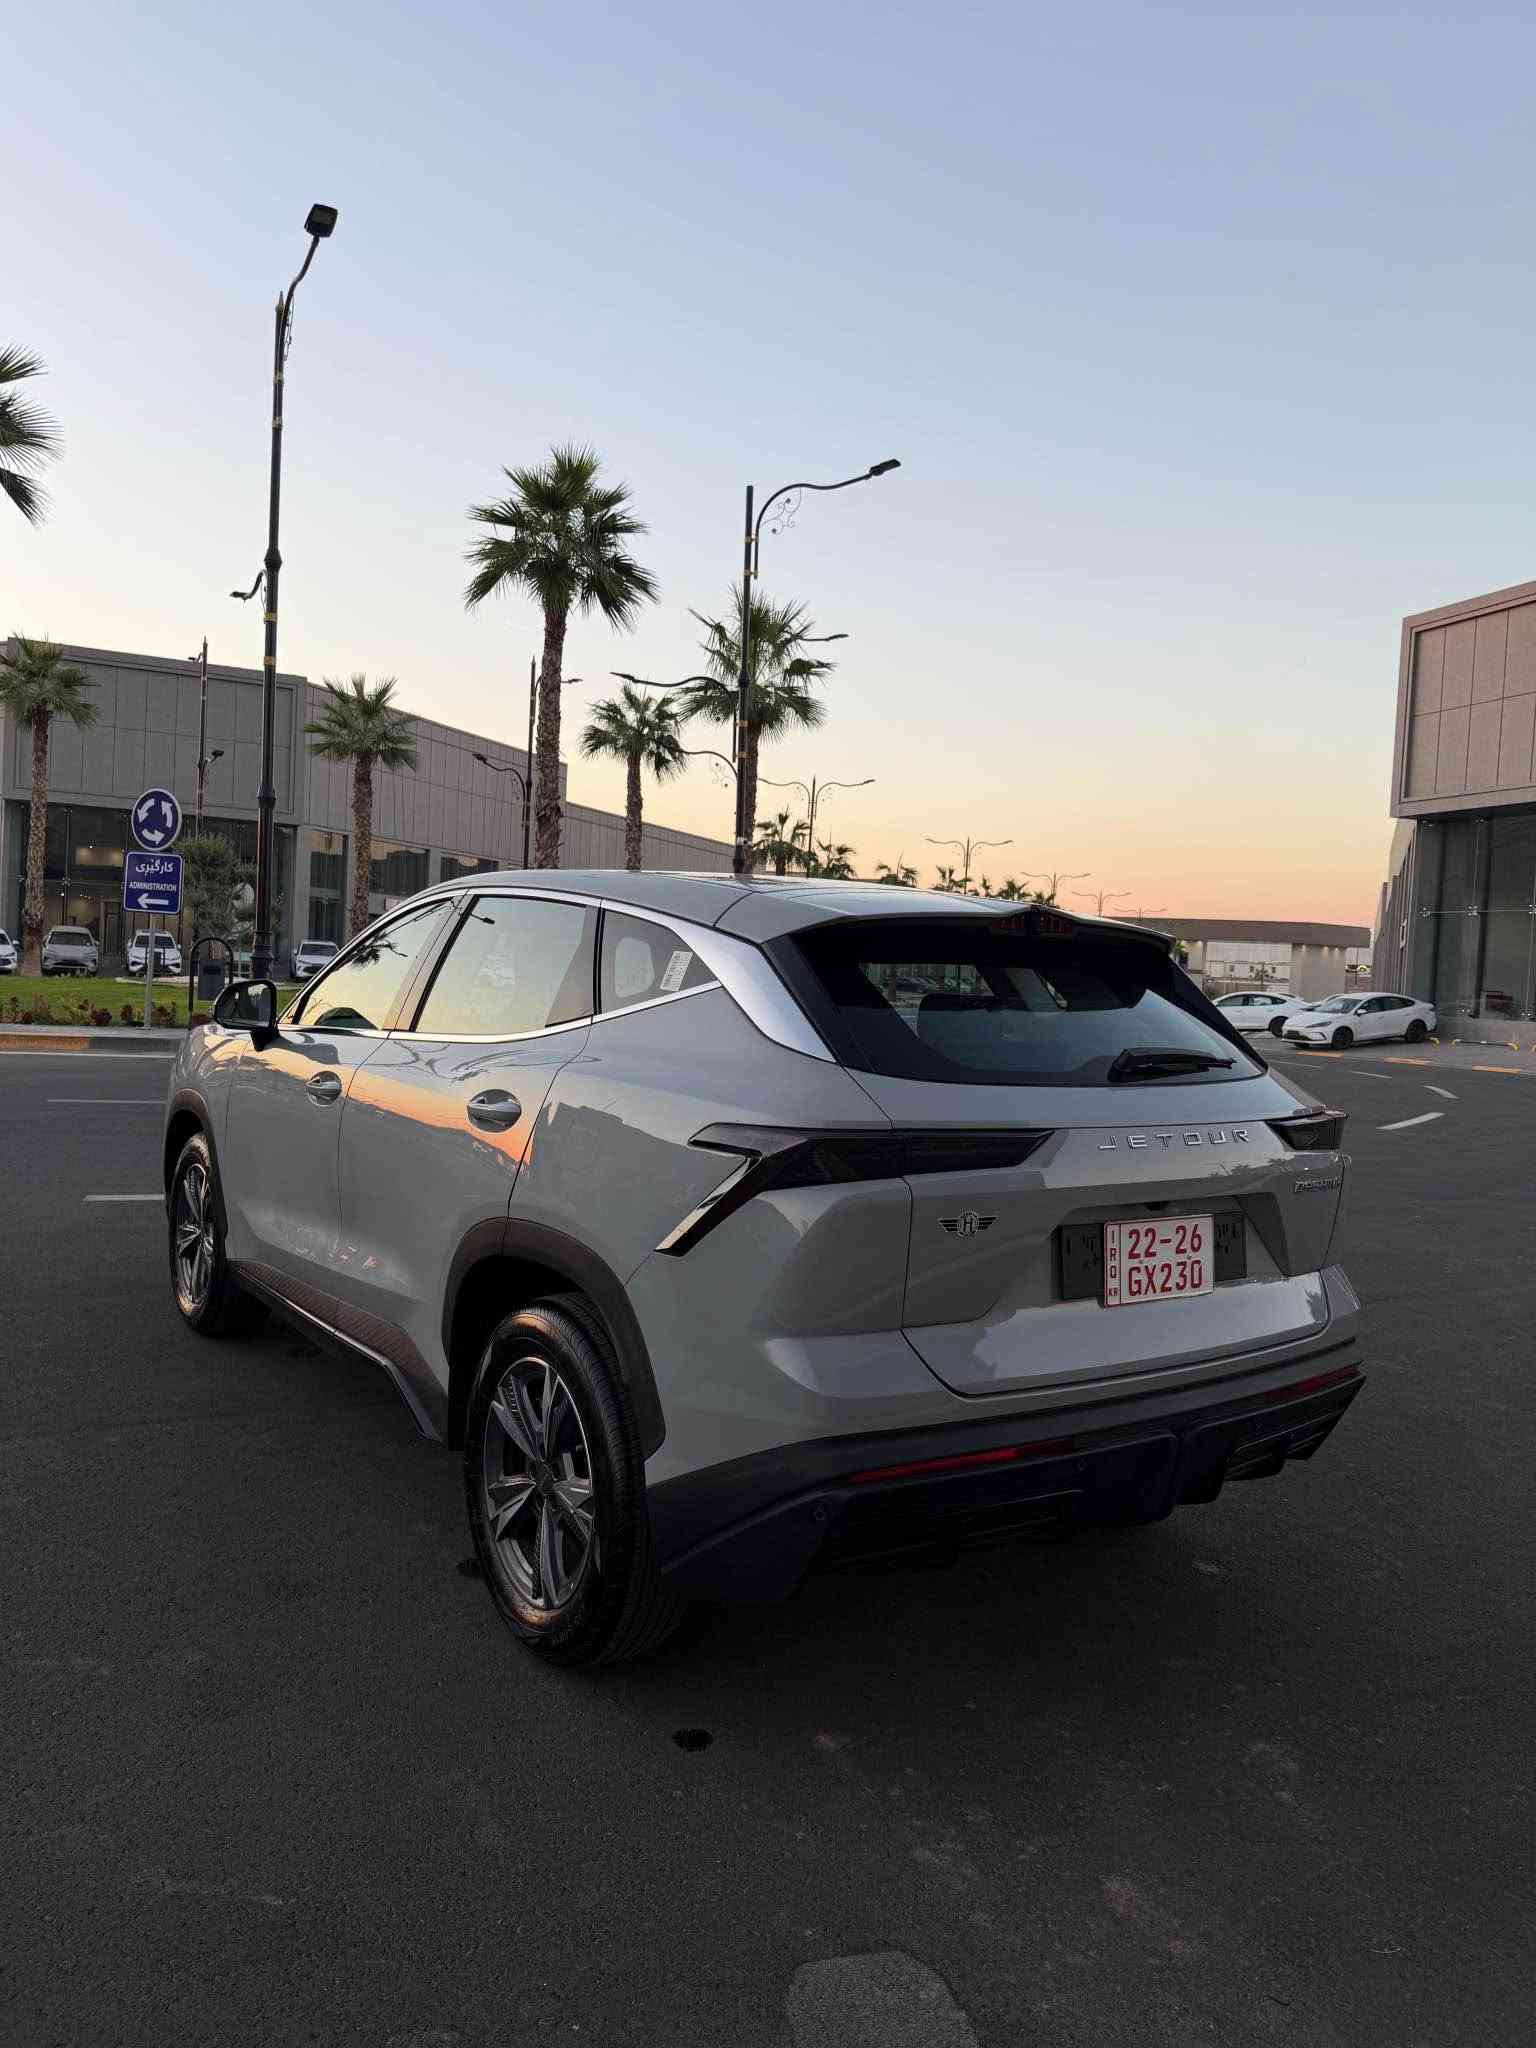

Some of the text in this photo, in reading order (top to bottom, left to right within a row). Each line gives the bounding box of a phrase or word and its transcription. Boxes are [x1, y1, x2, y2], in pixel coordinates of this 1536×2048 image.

[128, 881, 177, 892] ADMINISTRATION
[1098, 1128, 1250, 1150] JETOUR
[1127, 1223, 1203, 1260] 22-26
[1127, 1259, 1203, 1297] GX230
